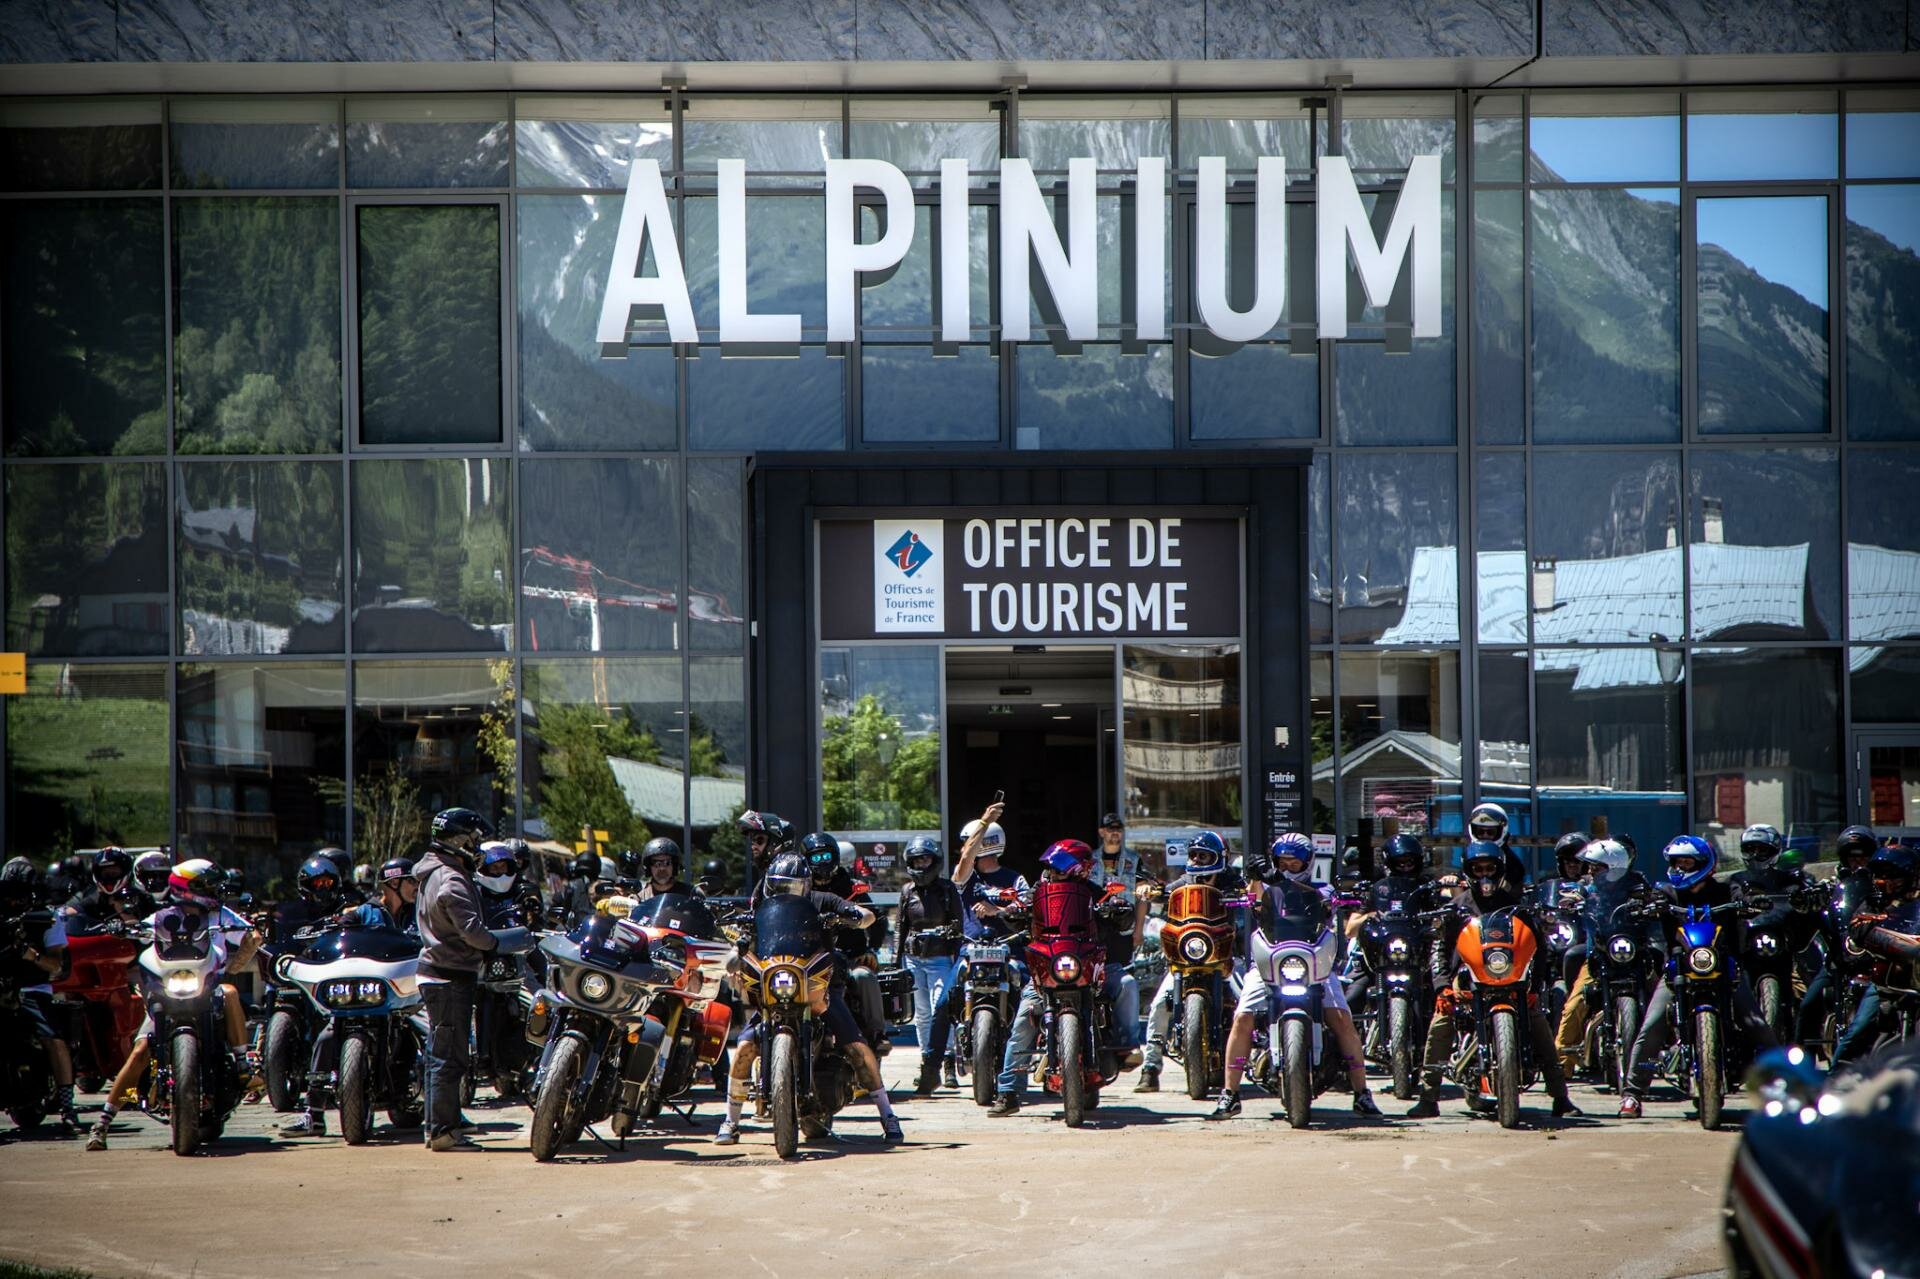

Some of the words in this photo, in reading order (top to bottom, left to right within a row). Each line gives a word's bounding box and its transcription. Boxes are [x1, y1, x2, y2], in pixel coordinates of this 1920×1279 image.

[596, 156, 1443, 344] ALPINIUM
[963, 518, 1111, 569] OFFICE
[1128, 518, 1182, 568] DE
[884, 583, 923, 595] Offices
[925, 585, 935, 595] de
[884, 597, 935, 609] Tourisme
[962, 582, 1188, 632] TOURISME
[884, 615, 894, 623] de
[896, 611, 935, 623] France
[1269, 772, 1296, 783] Entrée
